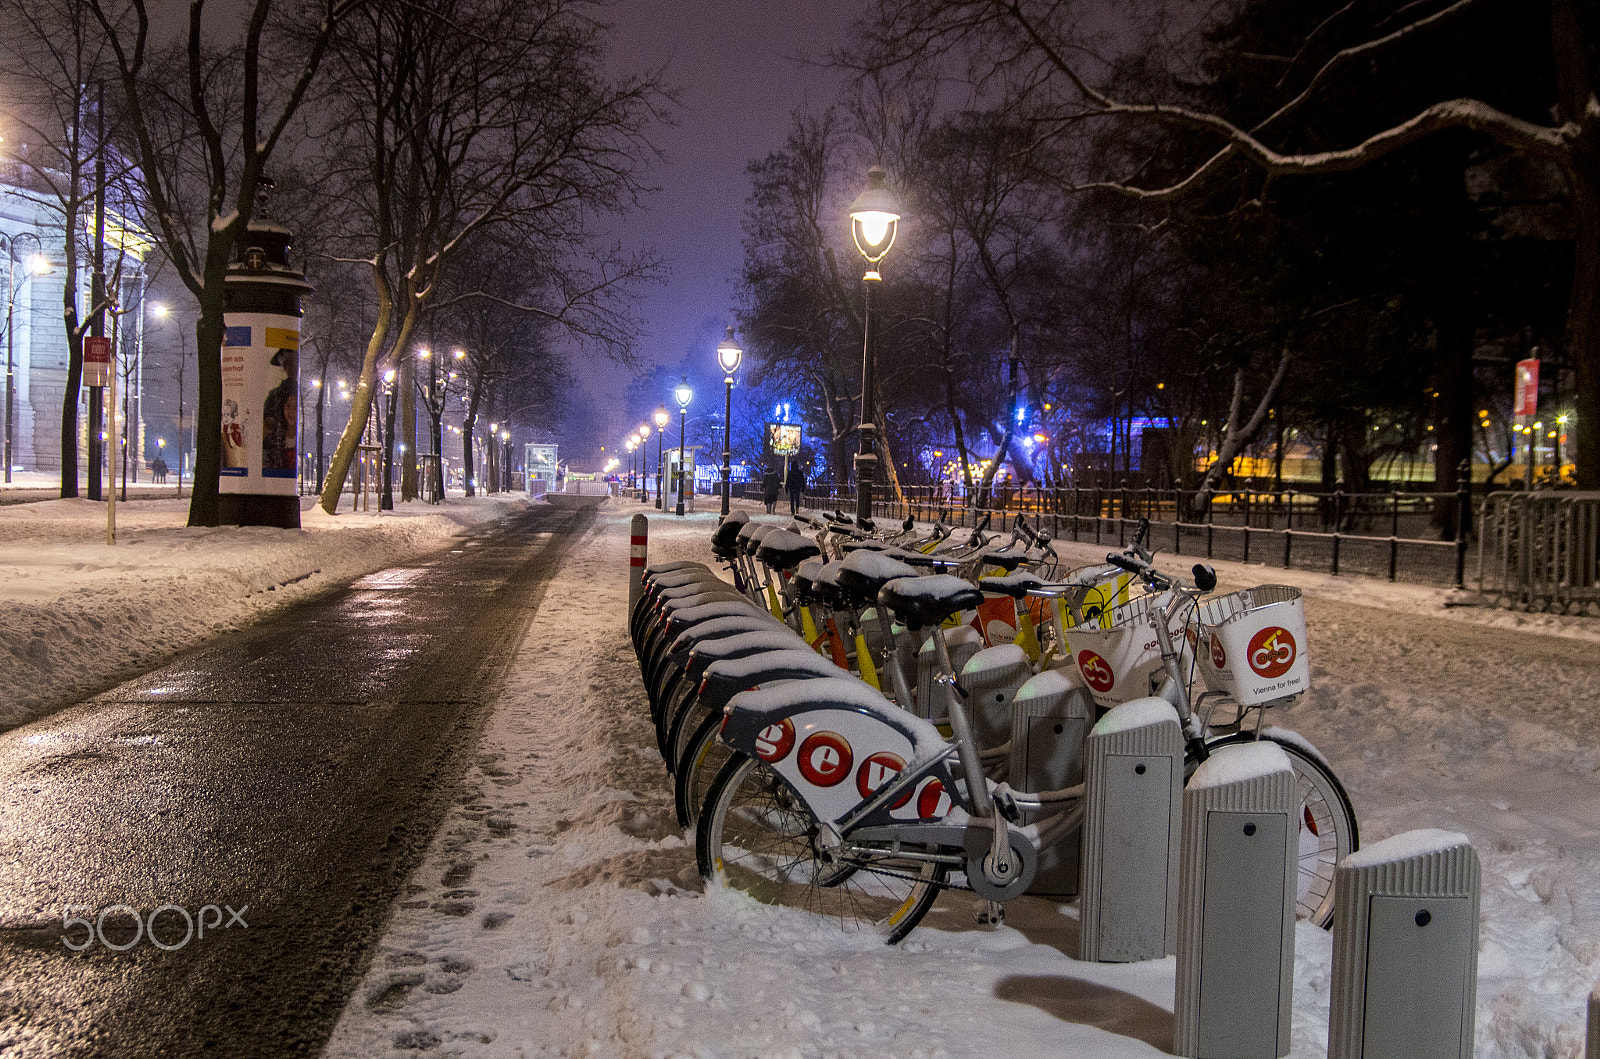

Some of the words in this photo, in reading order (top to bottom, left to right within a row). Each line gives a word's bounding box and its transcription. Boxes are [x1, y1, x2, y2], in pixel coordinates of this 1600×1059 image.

[1252, 684, 1277, 695] Vienna
[1277, 682, 1287, 690] for
[1287, 676, 1301, 687] free!
